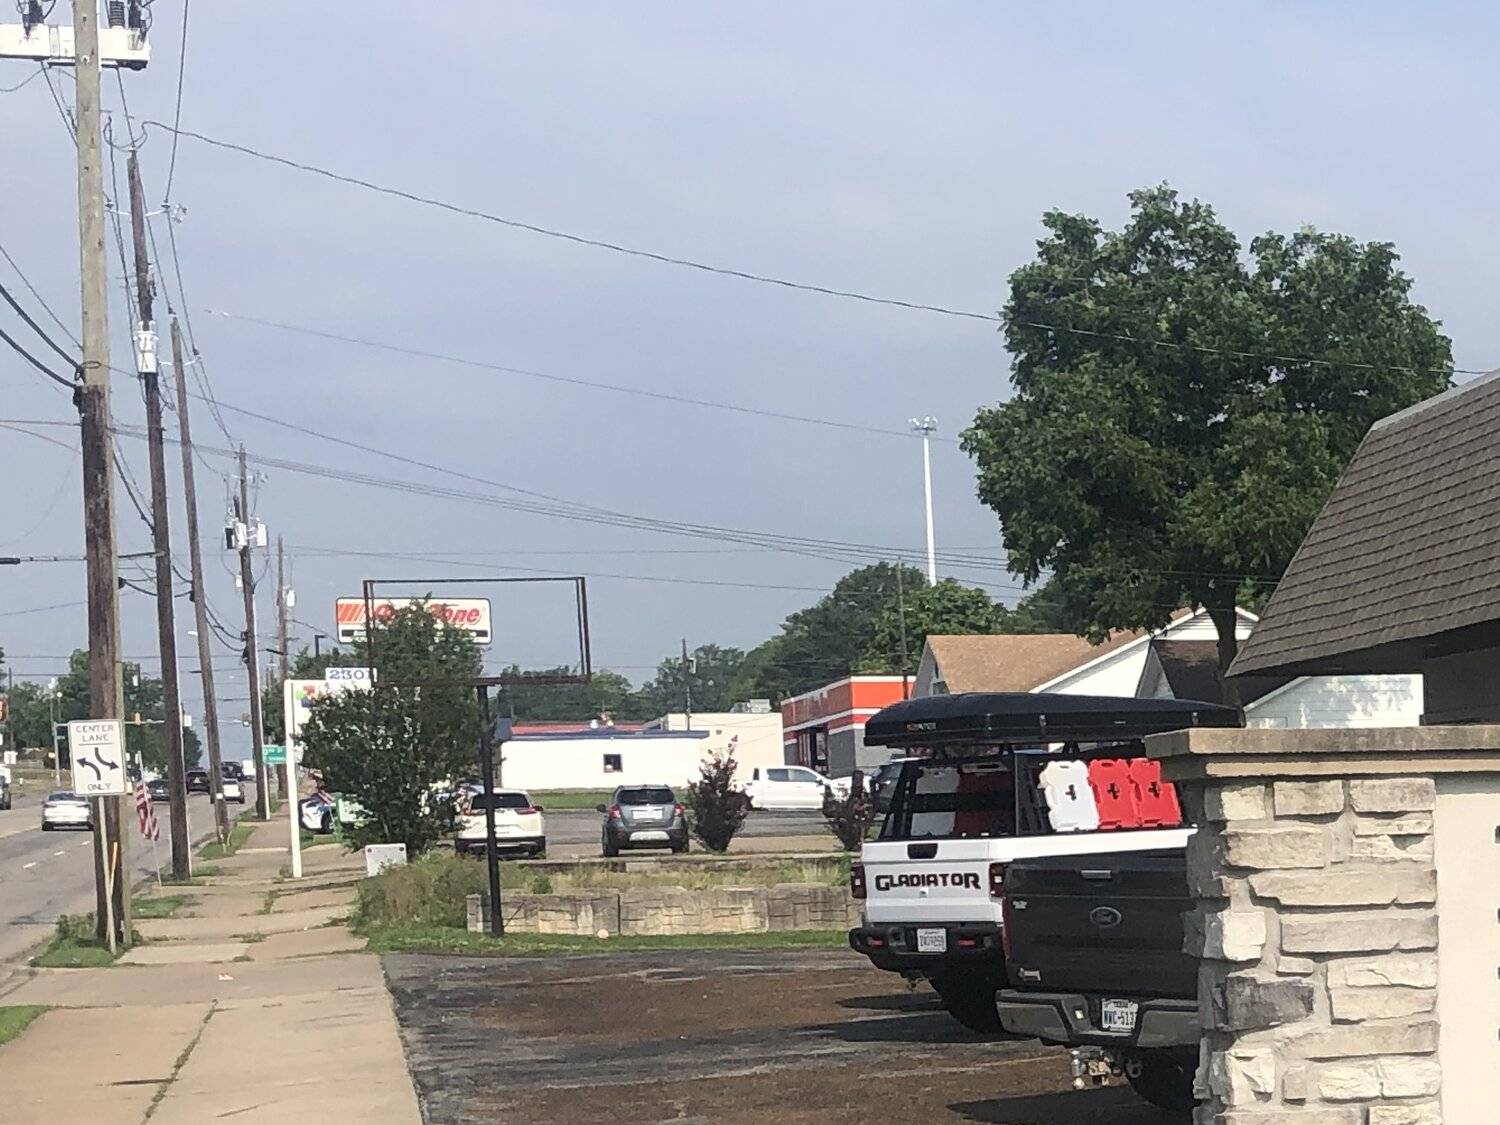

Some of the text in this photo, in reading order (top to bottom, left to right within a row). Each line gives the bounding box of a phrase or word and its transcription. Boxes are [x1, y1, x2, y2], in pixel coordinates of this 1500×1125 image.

[75, 724, 114, 733] CENTER
[82, 733, 109, 743] LANE
[87, 782, 112, 791] ONLY
[875, 873, 981, 891] GLADIATOR
